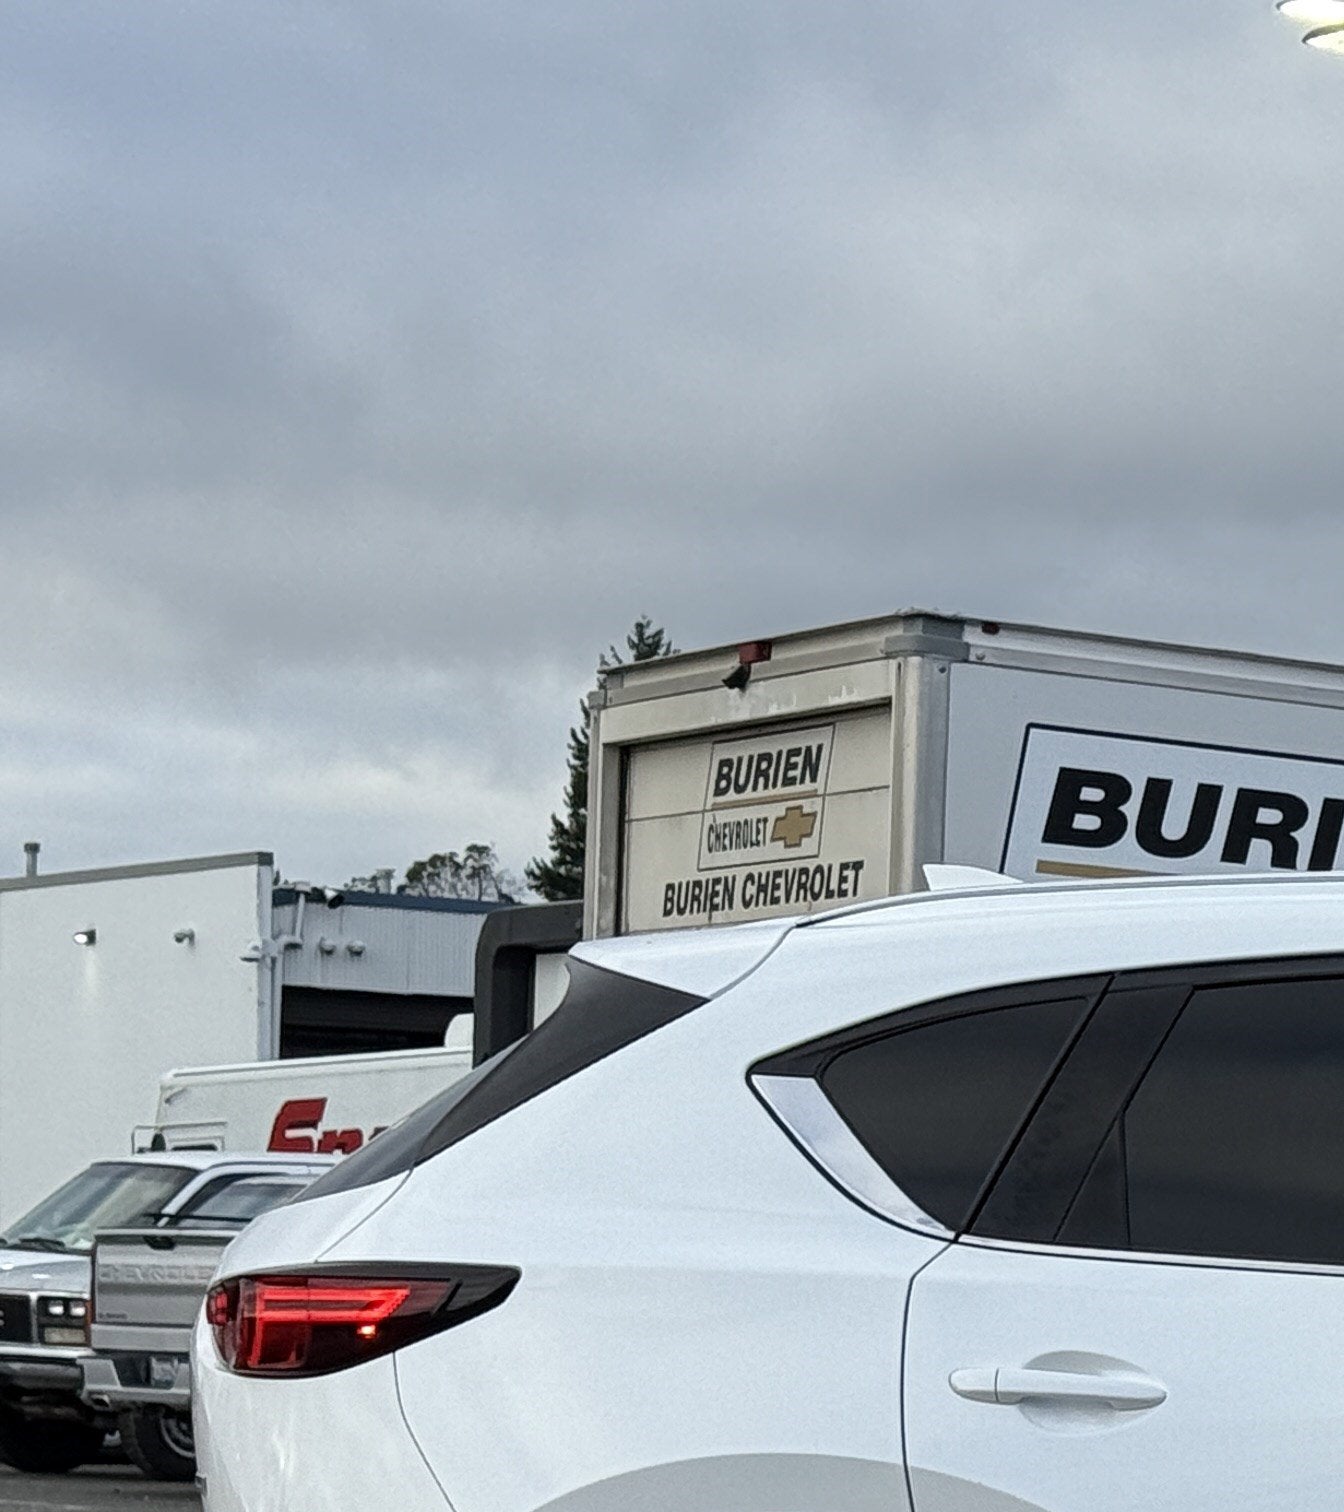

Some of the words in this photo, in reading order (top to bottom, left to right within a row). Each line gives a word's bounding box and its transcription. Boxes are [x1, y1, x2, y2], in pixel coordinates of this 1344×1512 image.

[713, 743, 824, 797] BURIEN
[707, 816, 769, 854] CHEVROLET
[662, 874, 736, 918] BURIEN
[741, 860, 865, 909] CHEVROLET
